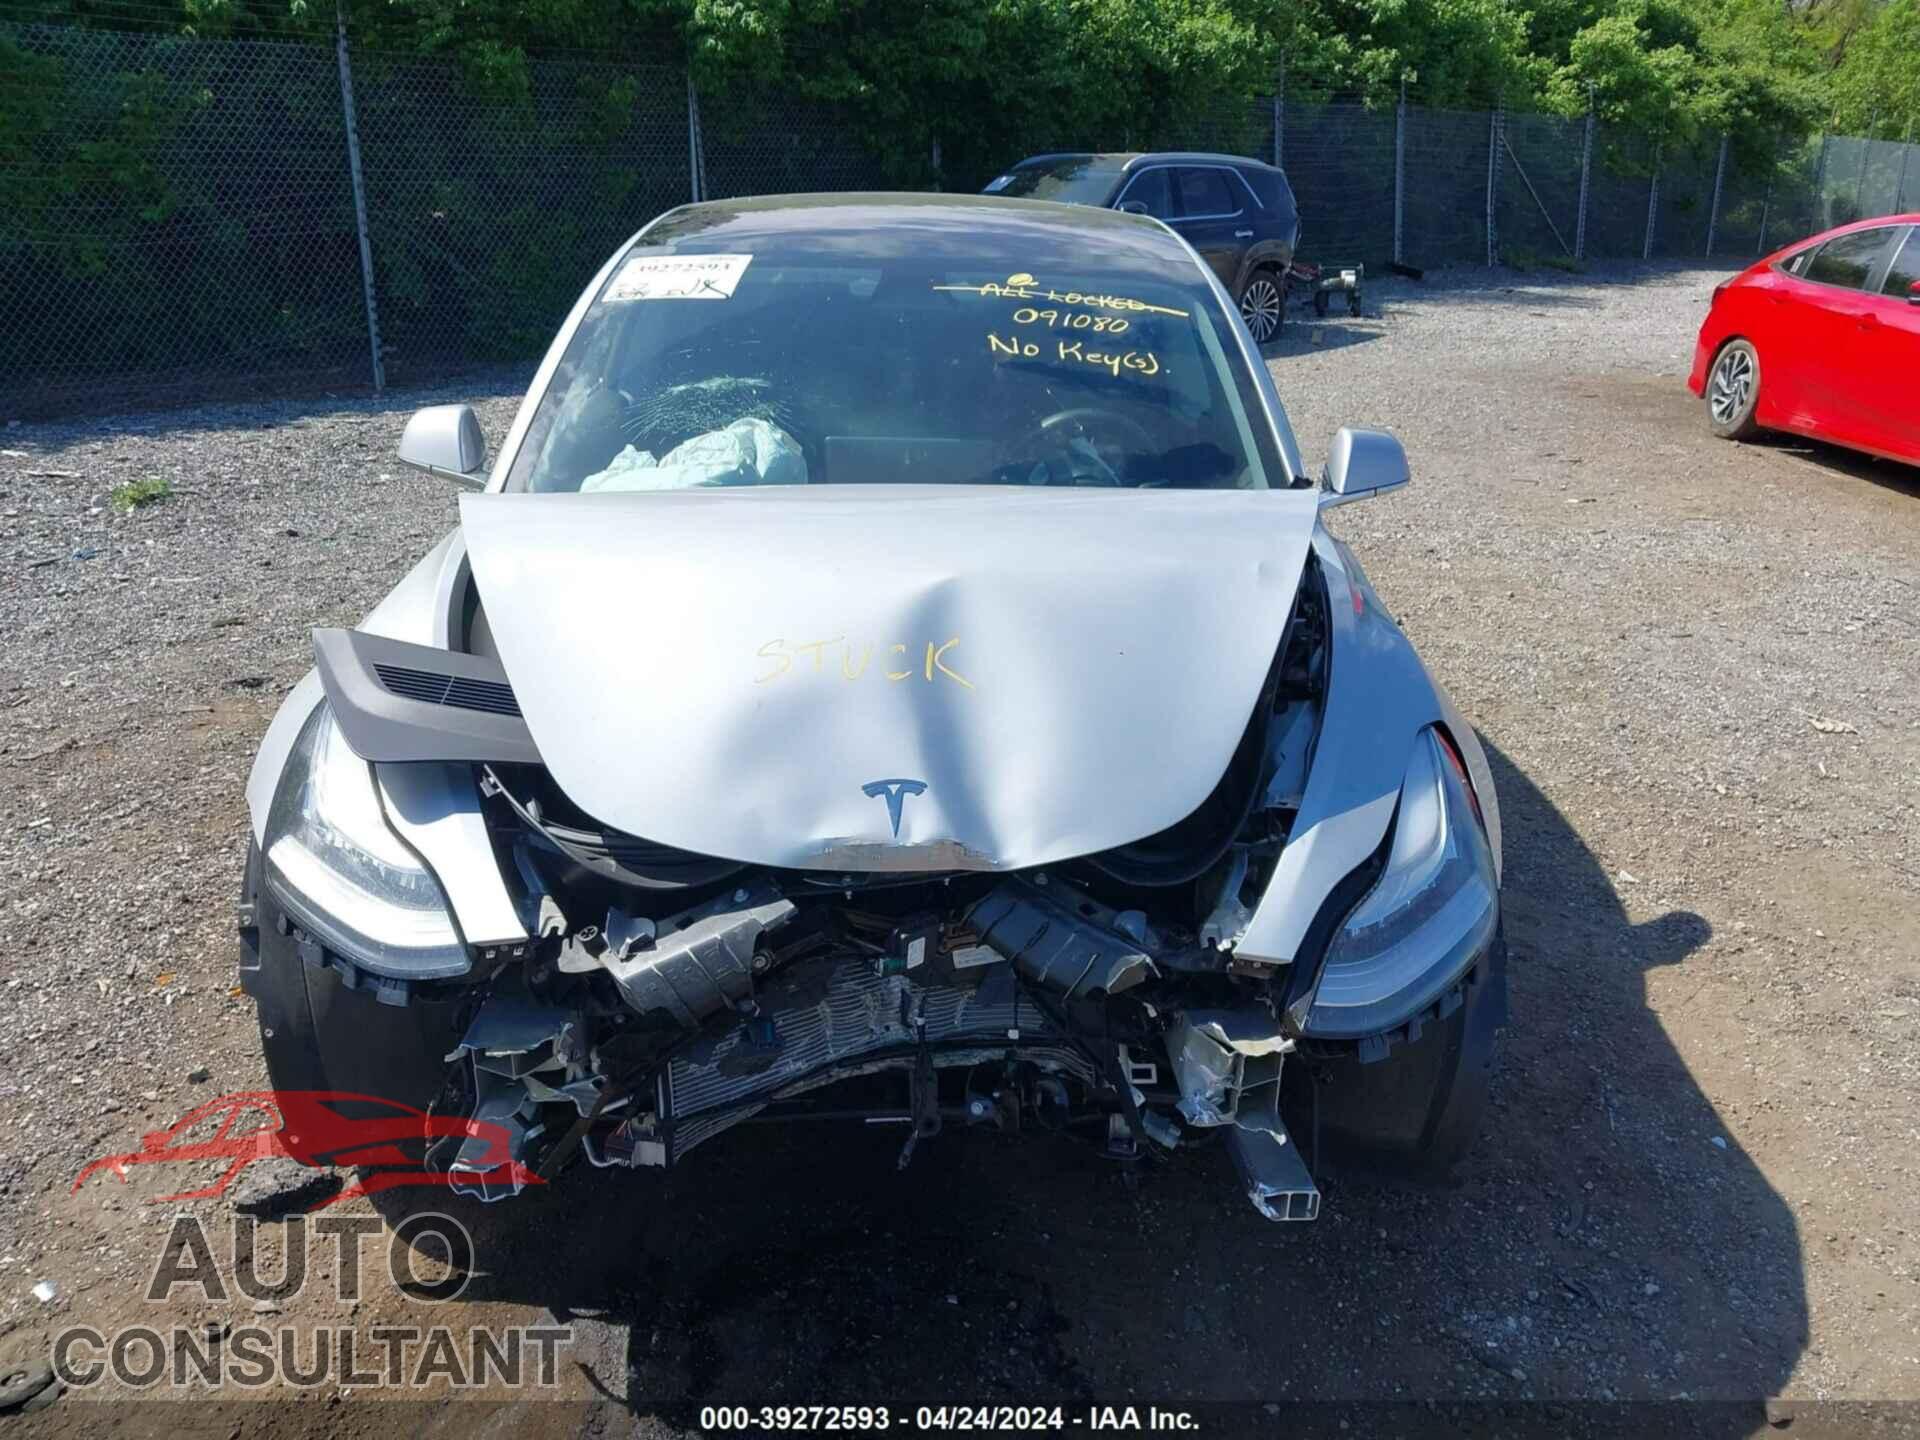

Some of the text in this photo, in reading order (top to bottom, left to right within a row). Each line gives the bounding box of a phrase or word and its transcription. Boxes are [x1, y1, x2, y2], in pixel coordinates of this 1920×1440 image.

[1013, 308, 1129, 333] 091080
[987, 334, 1040, 356] No
[754, 634, 976, 690] STUCK
